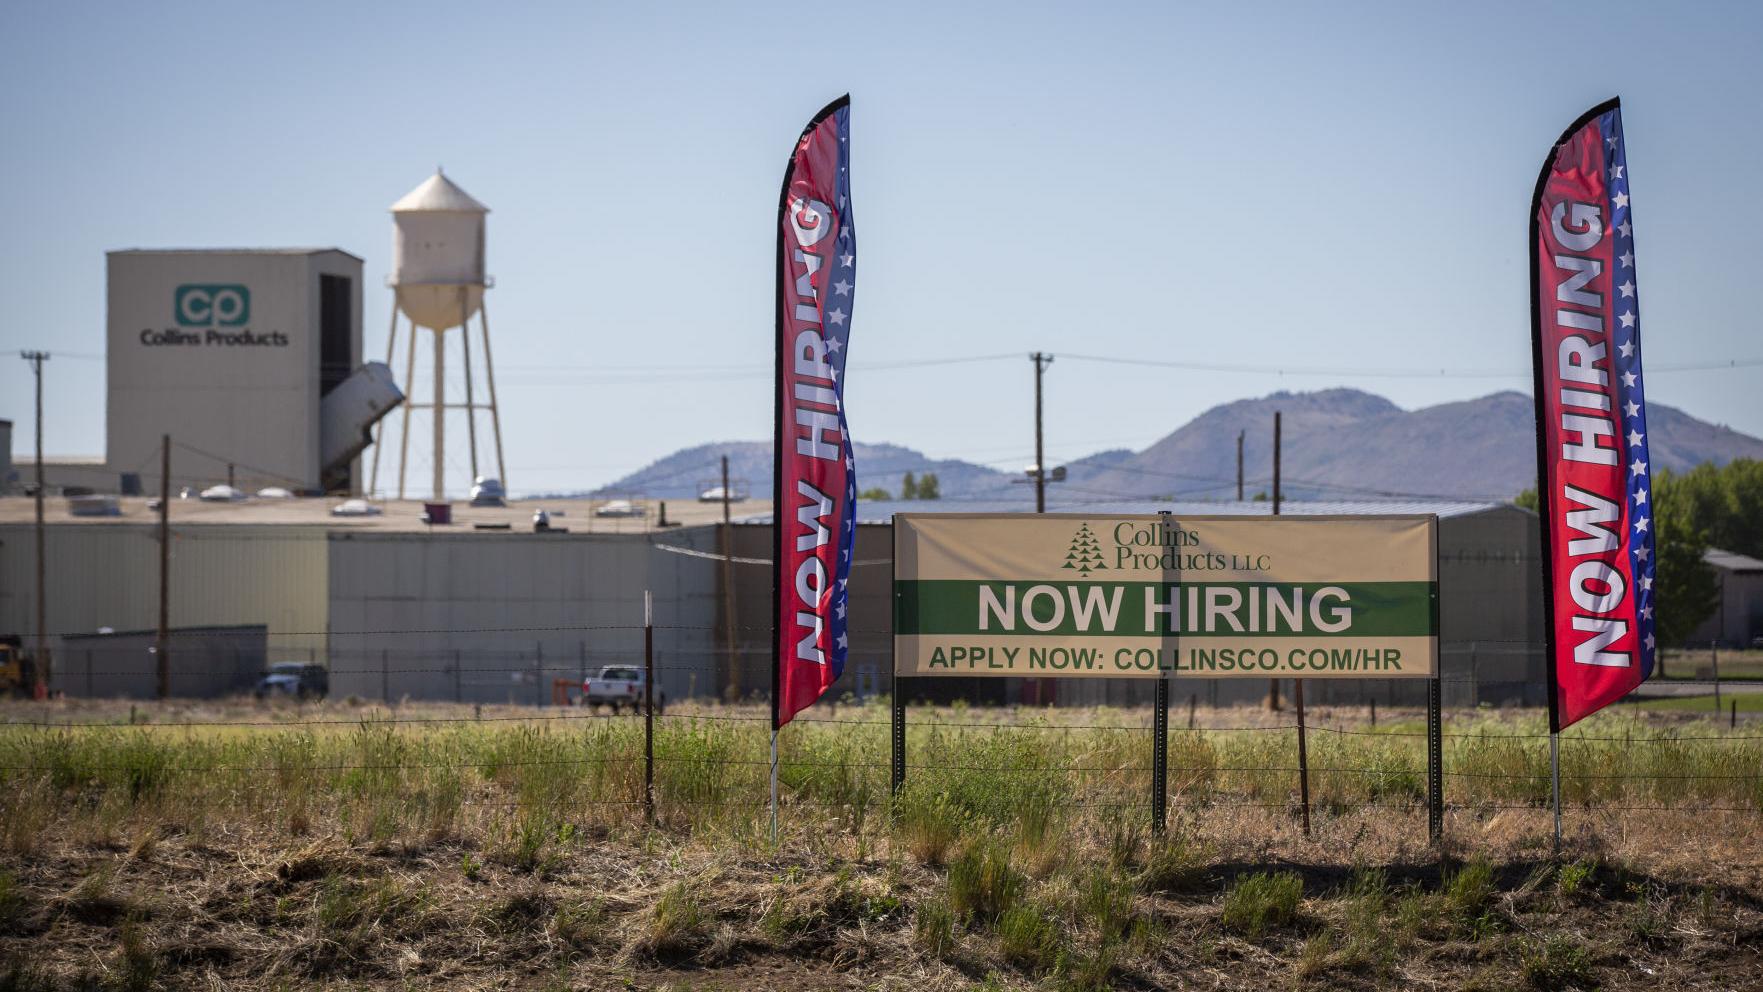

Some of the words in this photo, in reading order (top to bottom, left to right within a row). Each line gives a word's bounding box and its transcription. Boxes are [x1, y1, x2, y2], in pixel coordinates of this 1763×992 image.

[140, 329, 201, 347] Collins
[206, 329, 289, 347] Products
[1550, 201, 1619, 467] HIRING
[1113, 521, 1200, 547] Collins
[795, 479, 833, 665] NOW
[1114, 547, 1226, 571] Products
[1232, 556, 1271, 571] LLC
[1563, 483, 1633, 668] NOW
[978, 584, 1124, 632] NOW
[1144, 585, 1353, 633] HIRING
[929, 647, 1019, 670] APPLY
[1029, 648, 1105, 671] NOW:
[1114, 648, 1403, 672] COLLINSCO.COM/HR
